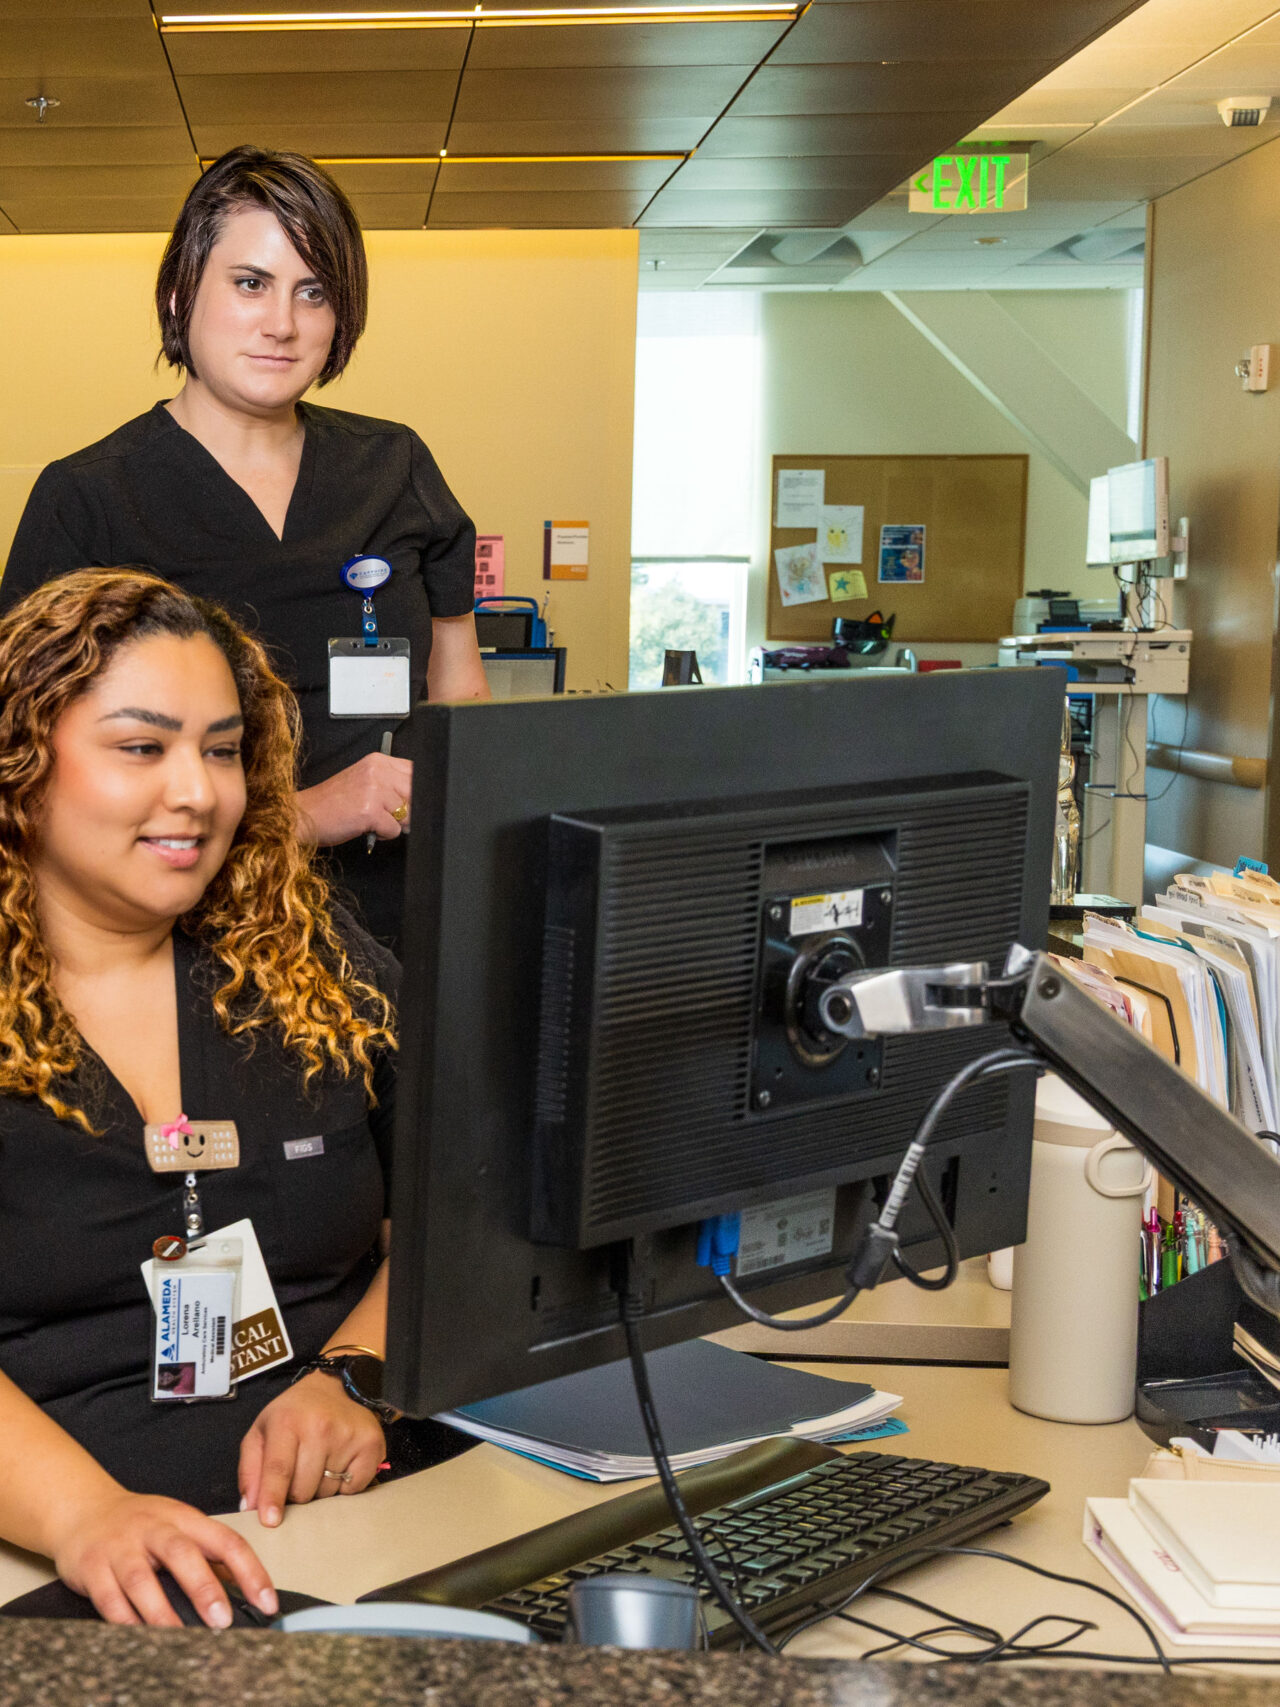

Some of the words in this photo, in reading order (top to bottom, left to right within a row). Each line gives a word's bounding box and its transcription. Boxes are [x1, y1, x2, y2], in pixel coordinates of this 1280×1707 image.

[933, 156, 1011, 209] EXIT
[294, 1142, 313, 1153] FIGS
[160, 1278, 172, 1342] ALAMEDA
[181, 1304, 190, 1336] Lorena
[192, 1300, 201, 1338] Arellano
